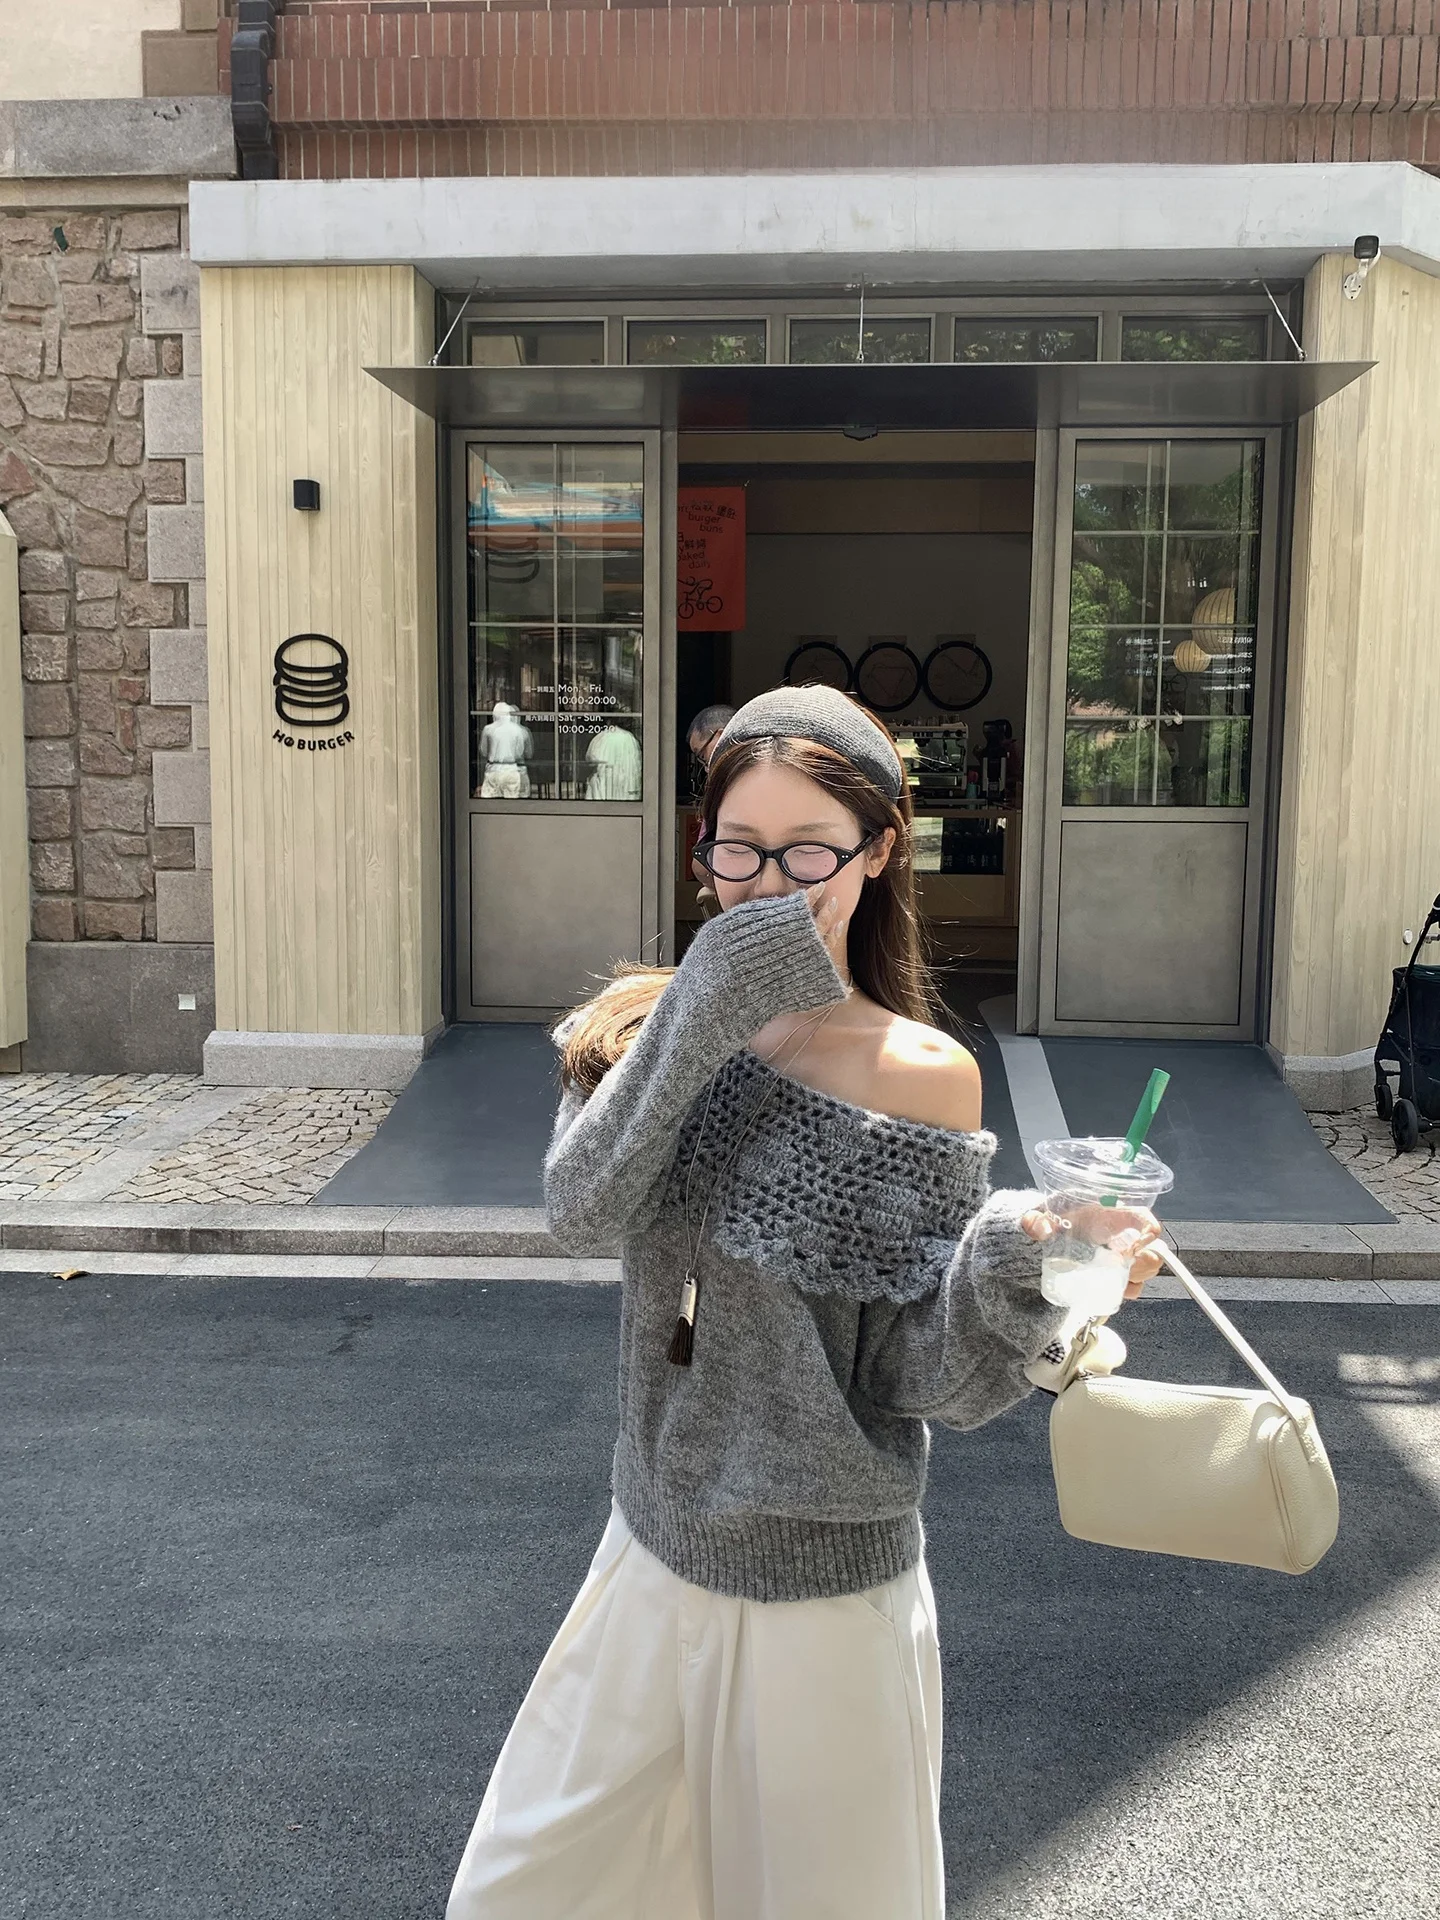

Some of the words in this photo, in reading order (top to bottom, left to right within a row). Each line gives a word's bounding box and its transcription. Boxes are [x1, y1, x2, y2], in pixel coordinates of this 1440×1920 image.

[688, 511, 721, 524] burger
[699, 524, 723, 533] buns
[558, 684, 581, 693] Mon.
[589, 684, 604, 693] Fri.
[558, 696, 617, 705] 10:00-20:00
[558, 713, 576, 722] Sat.
[583, 713, 604, 722] Sun.
[297, 731, 355, 751] BURGER
